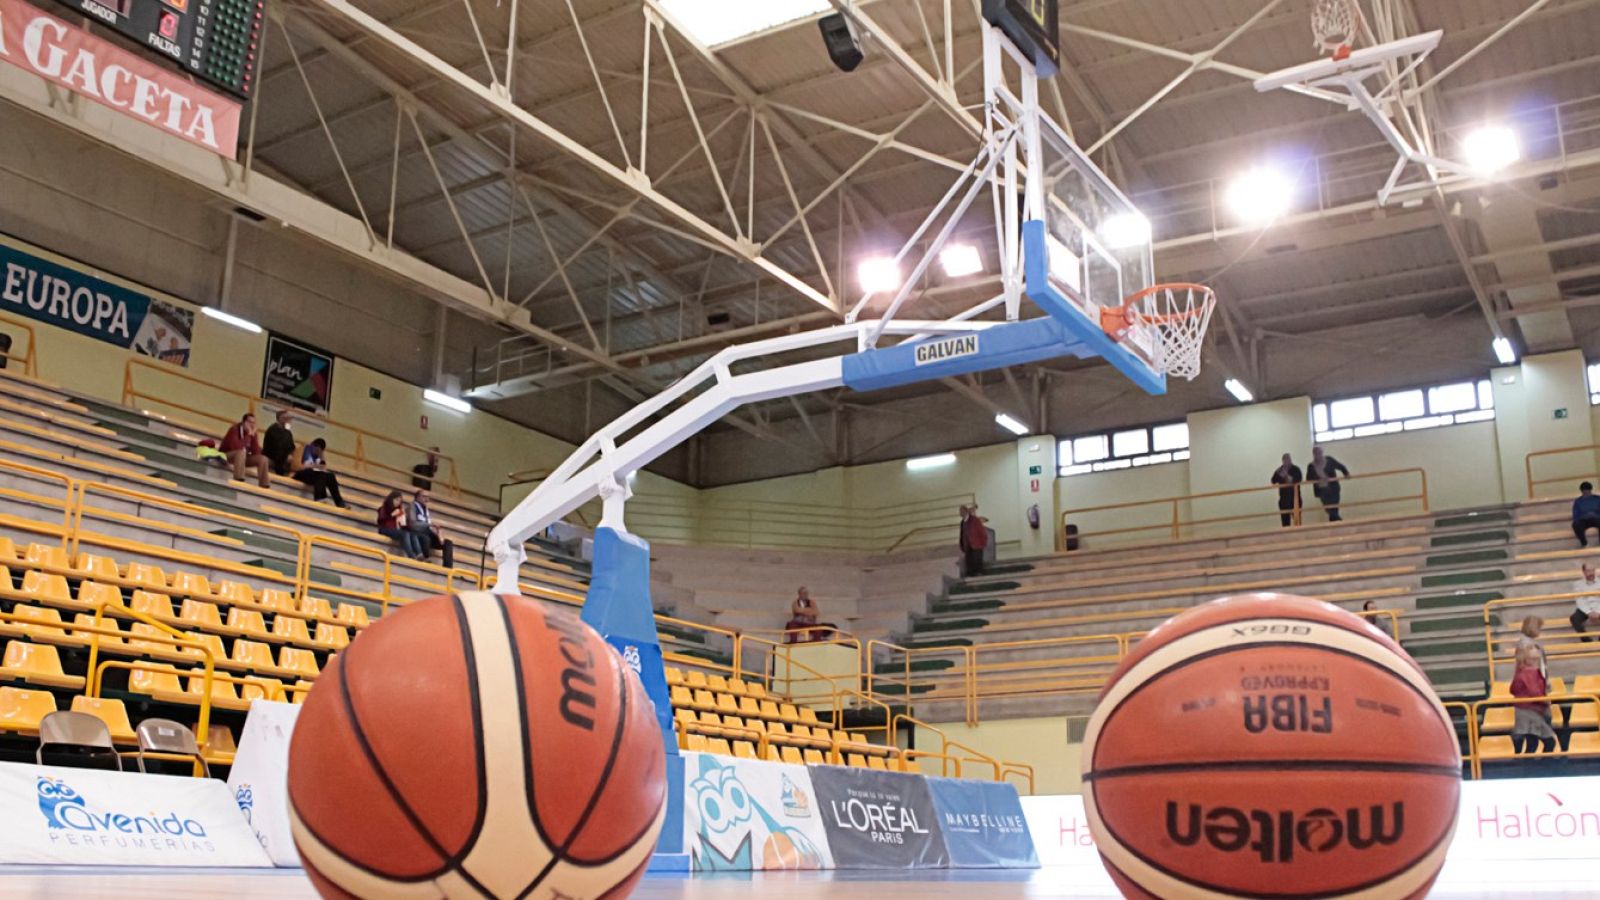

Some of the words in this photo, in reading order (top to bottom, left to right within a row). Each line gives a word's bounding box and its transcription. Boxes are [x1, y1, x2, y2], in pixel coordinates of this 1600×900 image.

[148, 32, 181, 57] FALTAS
[23, 17, 219, 149] GACETA
[2, 262, 129, 338] EUROPA
[917, 336, 975, 362] GALVAN
[268, 356, 303, 380] plan
[1243, 695, 1334, 734] FIBA
[831, 798, 929, 833] L'ORÉAL
[945, 812, 1024, 828] MAYBELLINE
[871, 831, 904, 845] PARIS
[1165, 801, 1404, 863] molten
